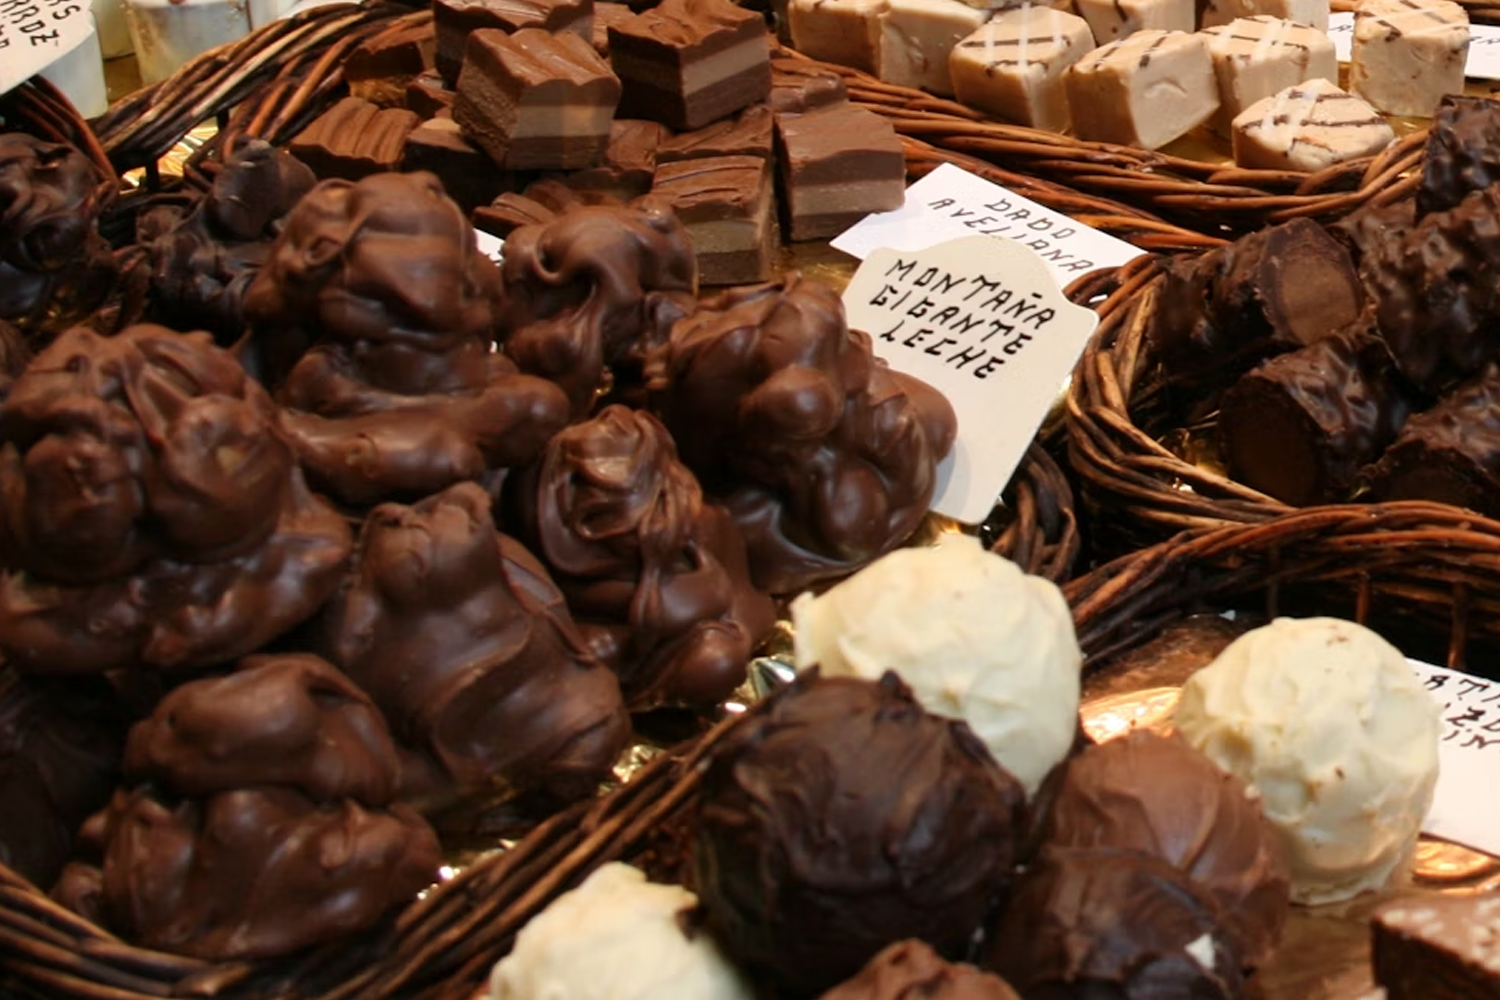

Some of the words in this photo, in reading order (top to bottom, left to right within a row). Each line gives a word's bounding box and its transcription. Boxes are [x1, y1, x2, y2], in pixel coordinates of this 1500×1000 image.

[869, 284, 1033, 355] GIGANTE
[885, 258, 1056, 329] MONTAÑA
[879, 320, 1005, 379] LECHE
